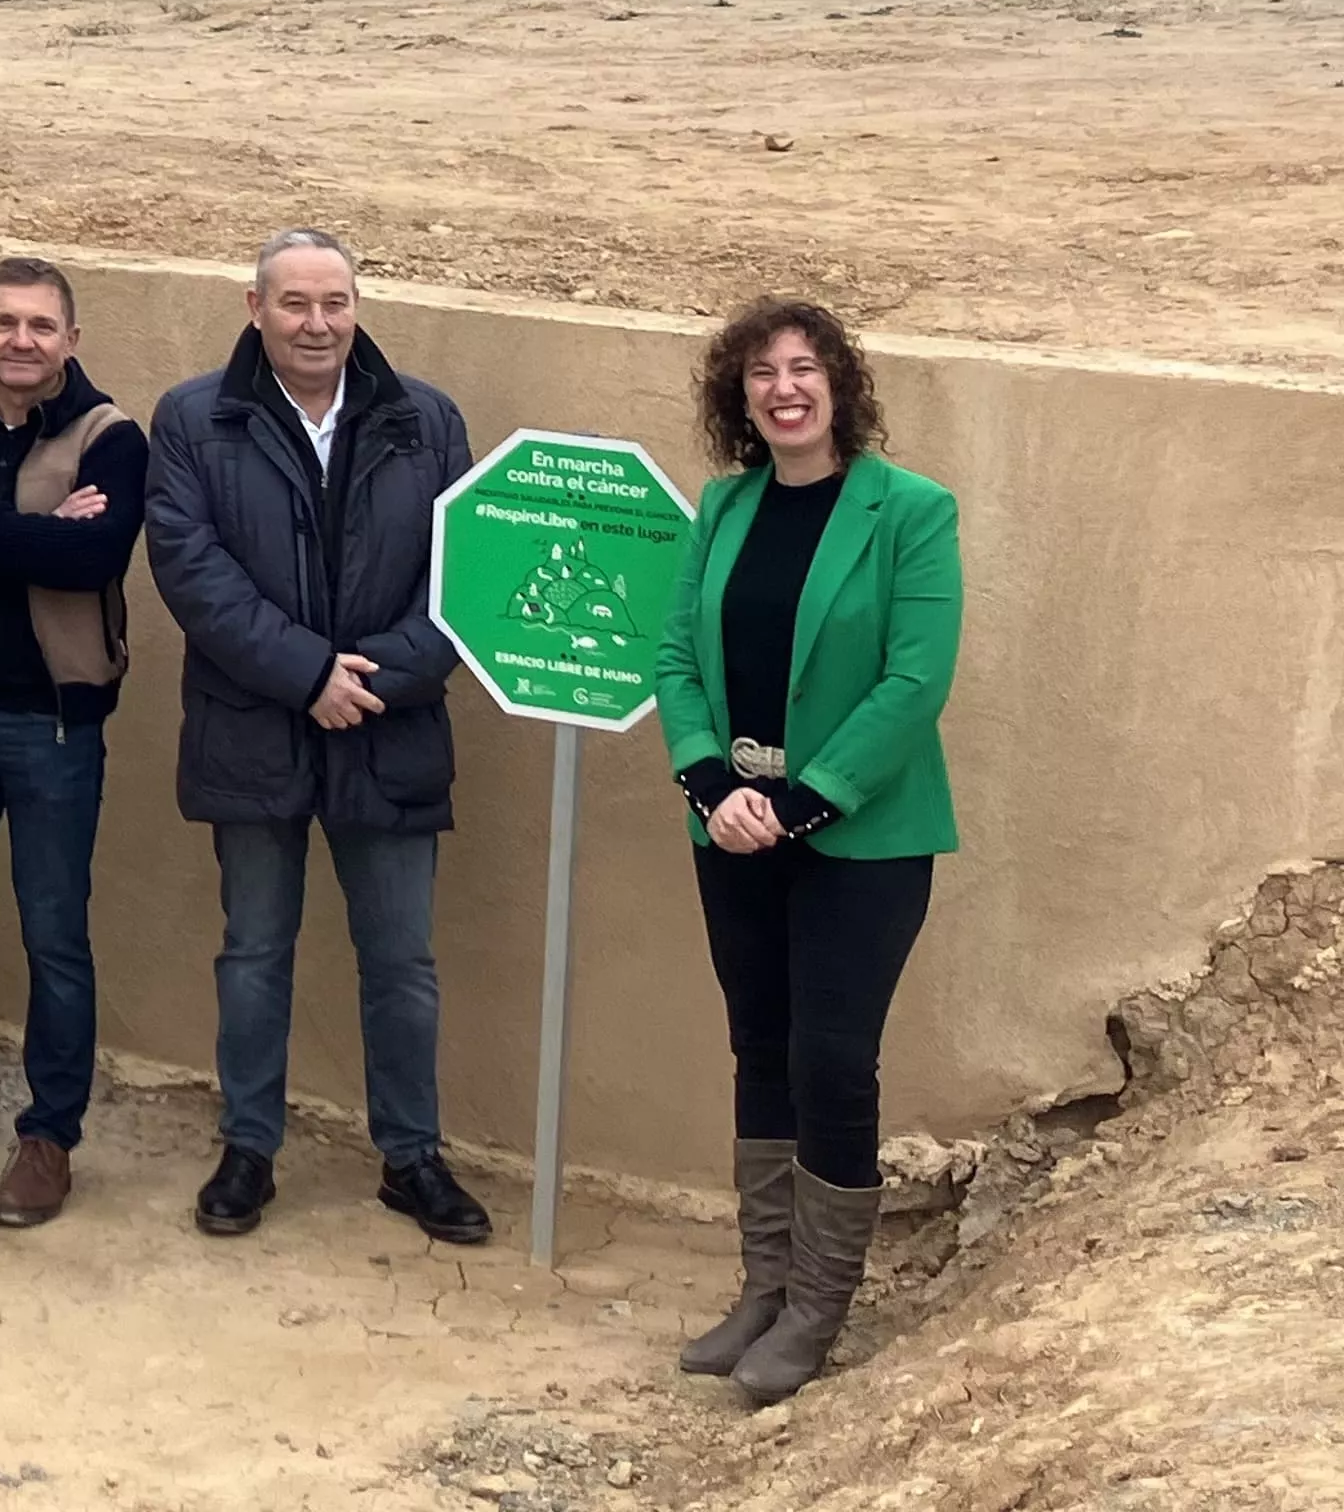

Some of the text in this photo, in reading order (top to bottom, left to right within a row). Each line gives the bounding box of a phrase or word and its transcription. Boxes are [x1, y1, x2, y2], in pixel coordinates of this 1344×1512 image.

[532, 450, 624, 477] En marcha
[506, 469, 649, 499] contra el cáncer
[475, 503, 678, 544] #RespiroLibre en este lugar
[495, 651, 642, 684] ESPACIO LIBRE DE HUMO
